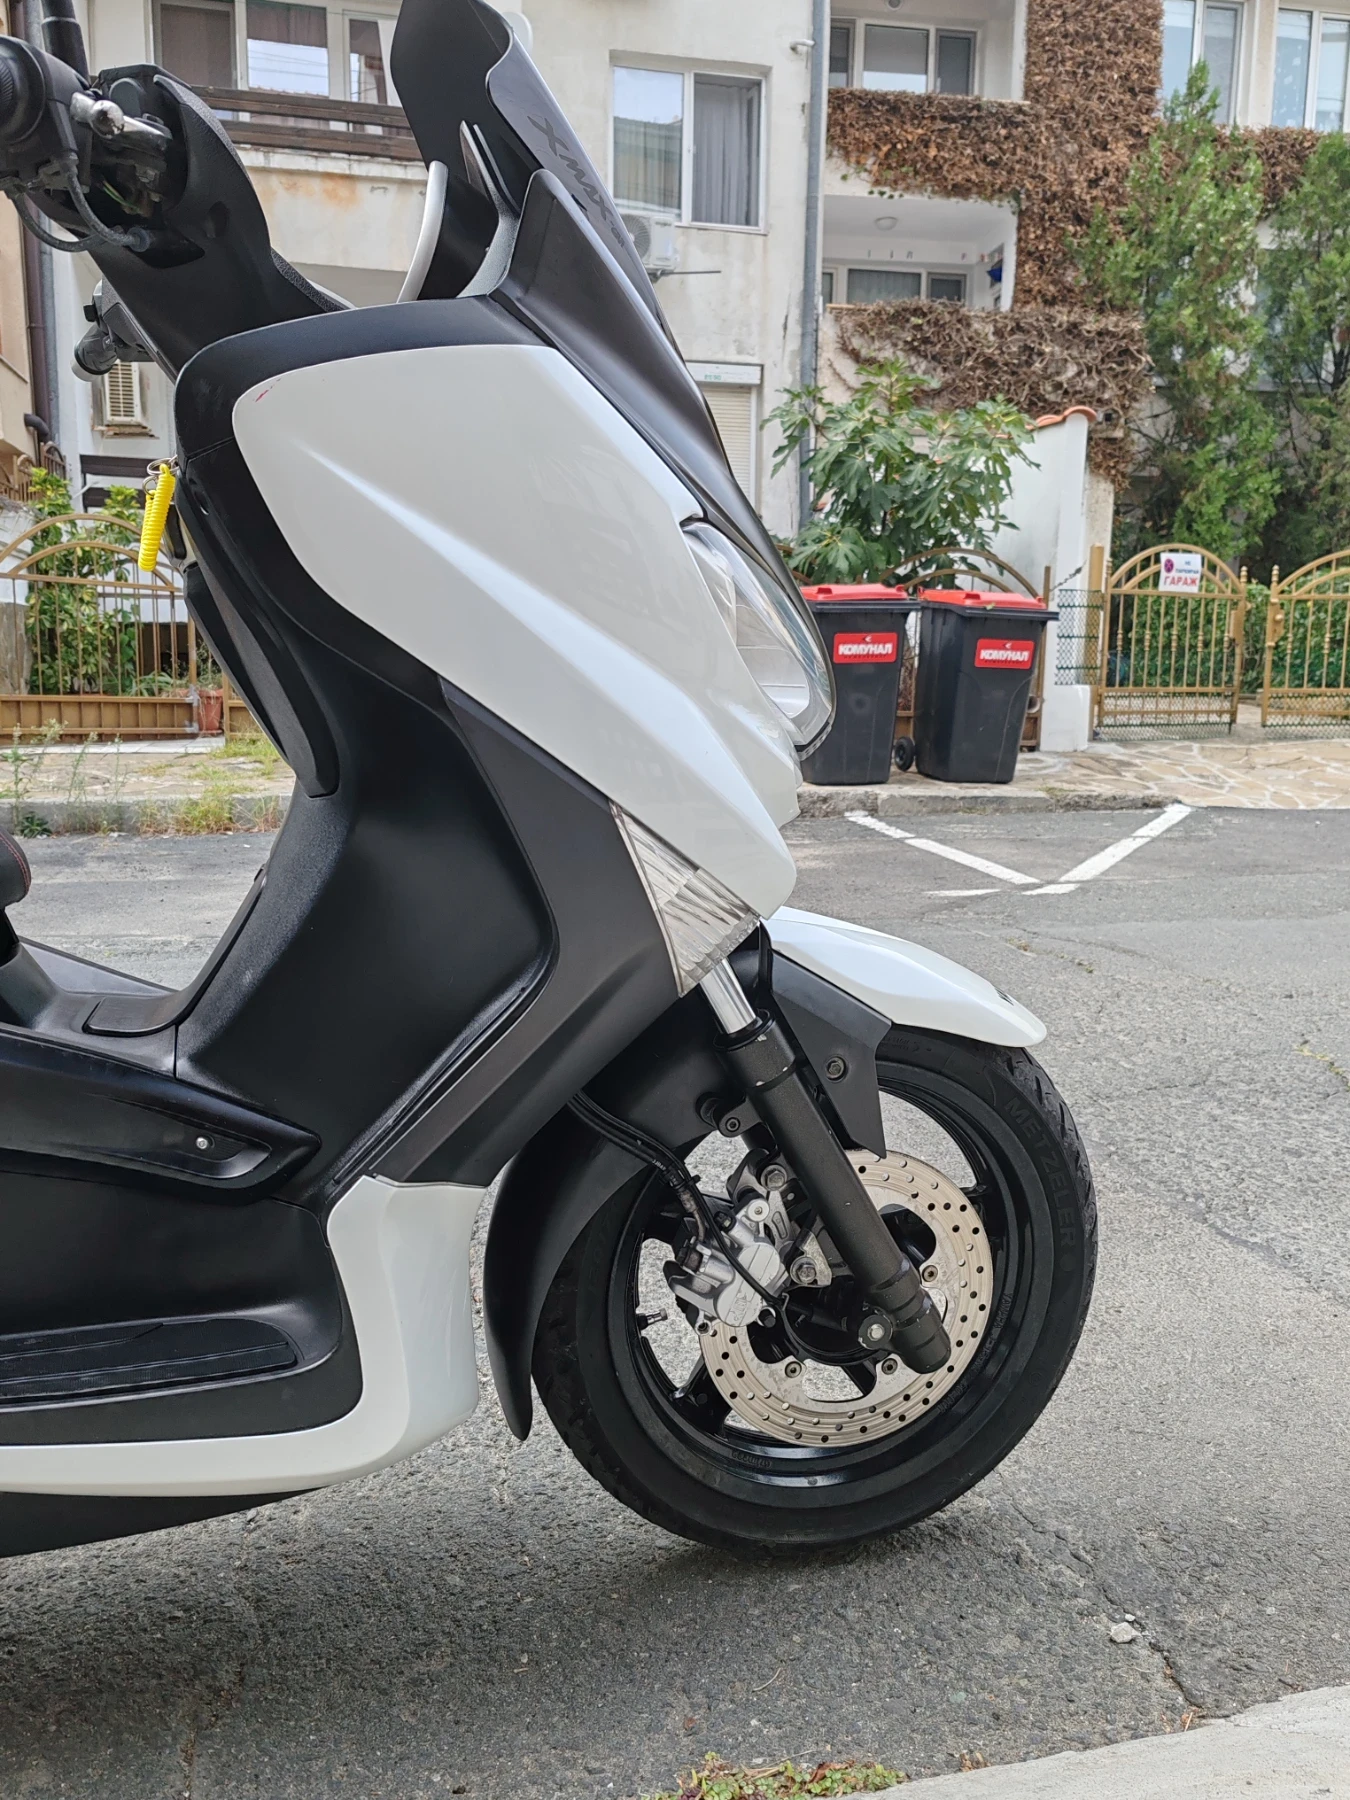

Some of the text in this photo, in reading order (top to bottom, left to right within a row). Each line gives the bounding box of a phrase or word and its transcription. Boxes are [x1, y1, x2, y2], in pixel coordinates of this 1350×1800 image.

[1164, 576, 1197, 586] ГАРАЖ
[838, 642, 893, 656] КОМУНАЛ
[979, 649, 1030, 662] КОМУНАЛ
[1003, 1096, 1078, 1248] METZELER
